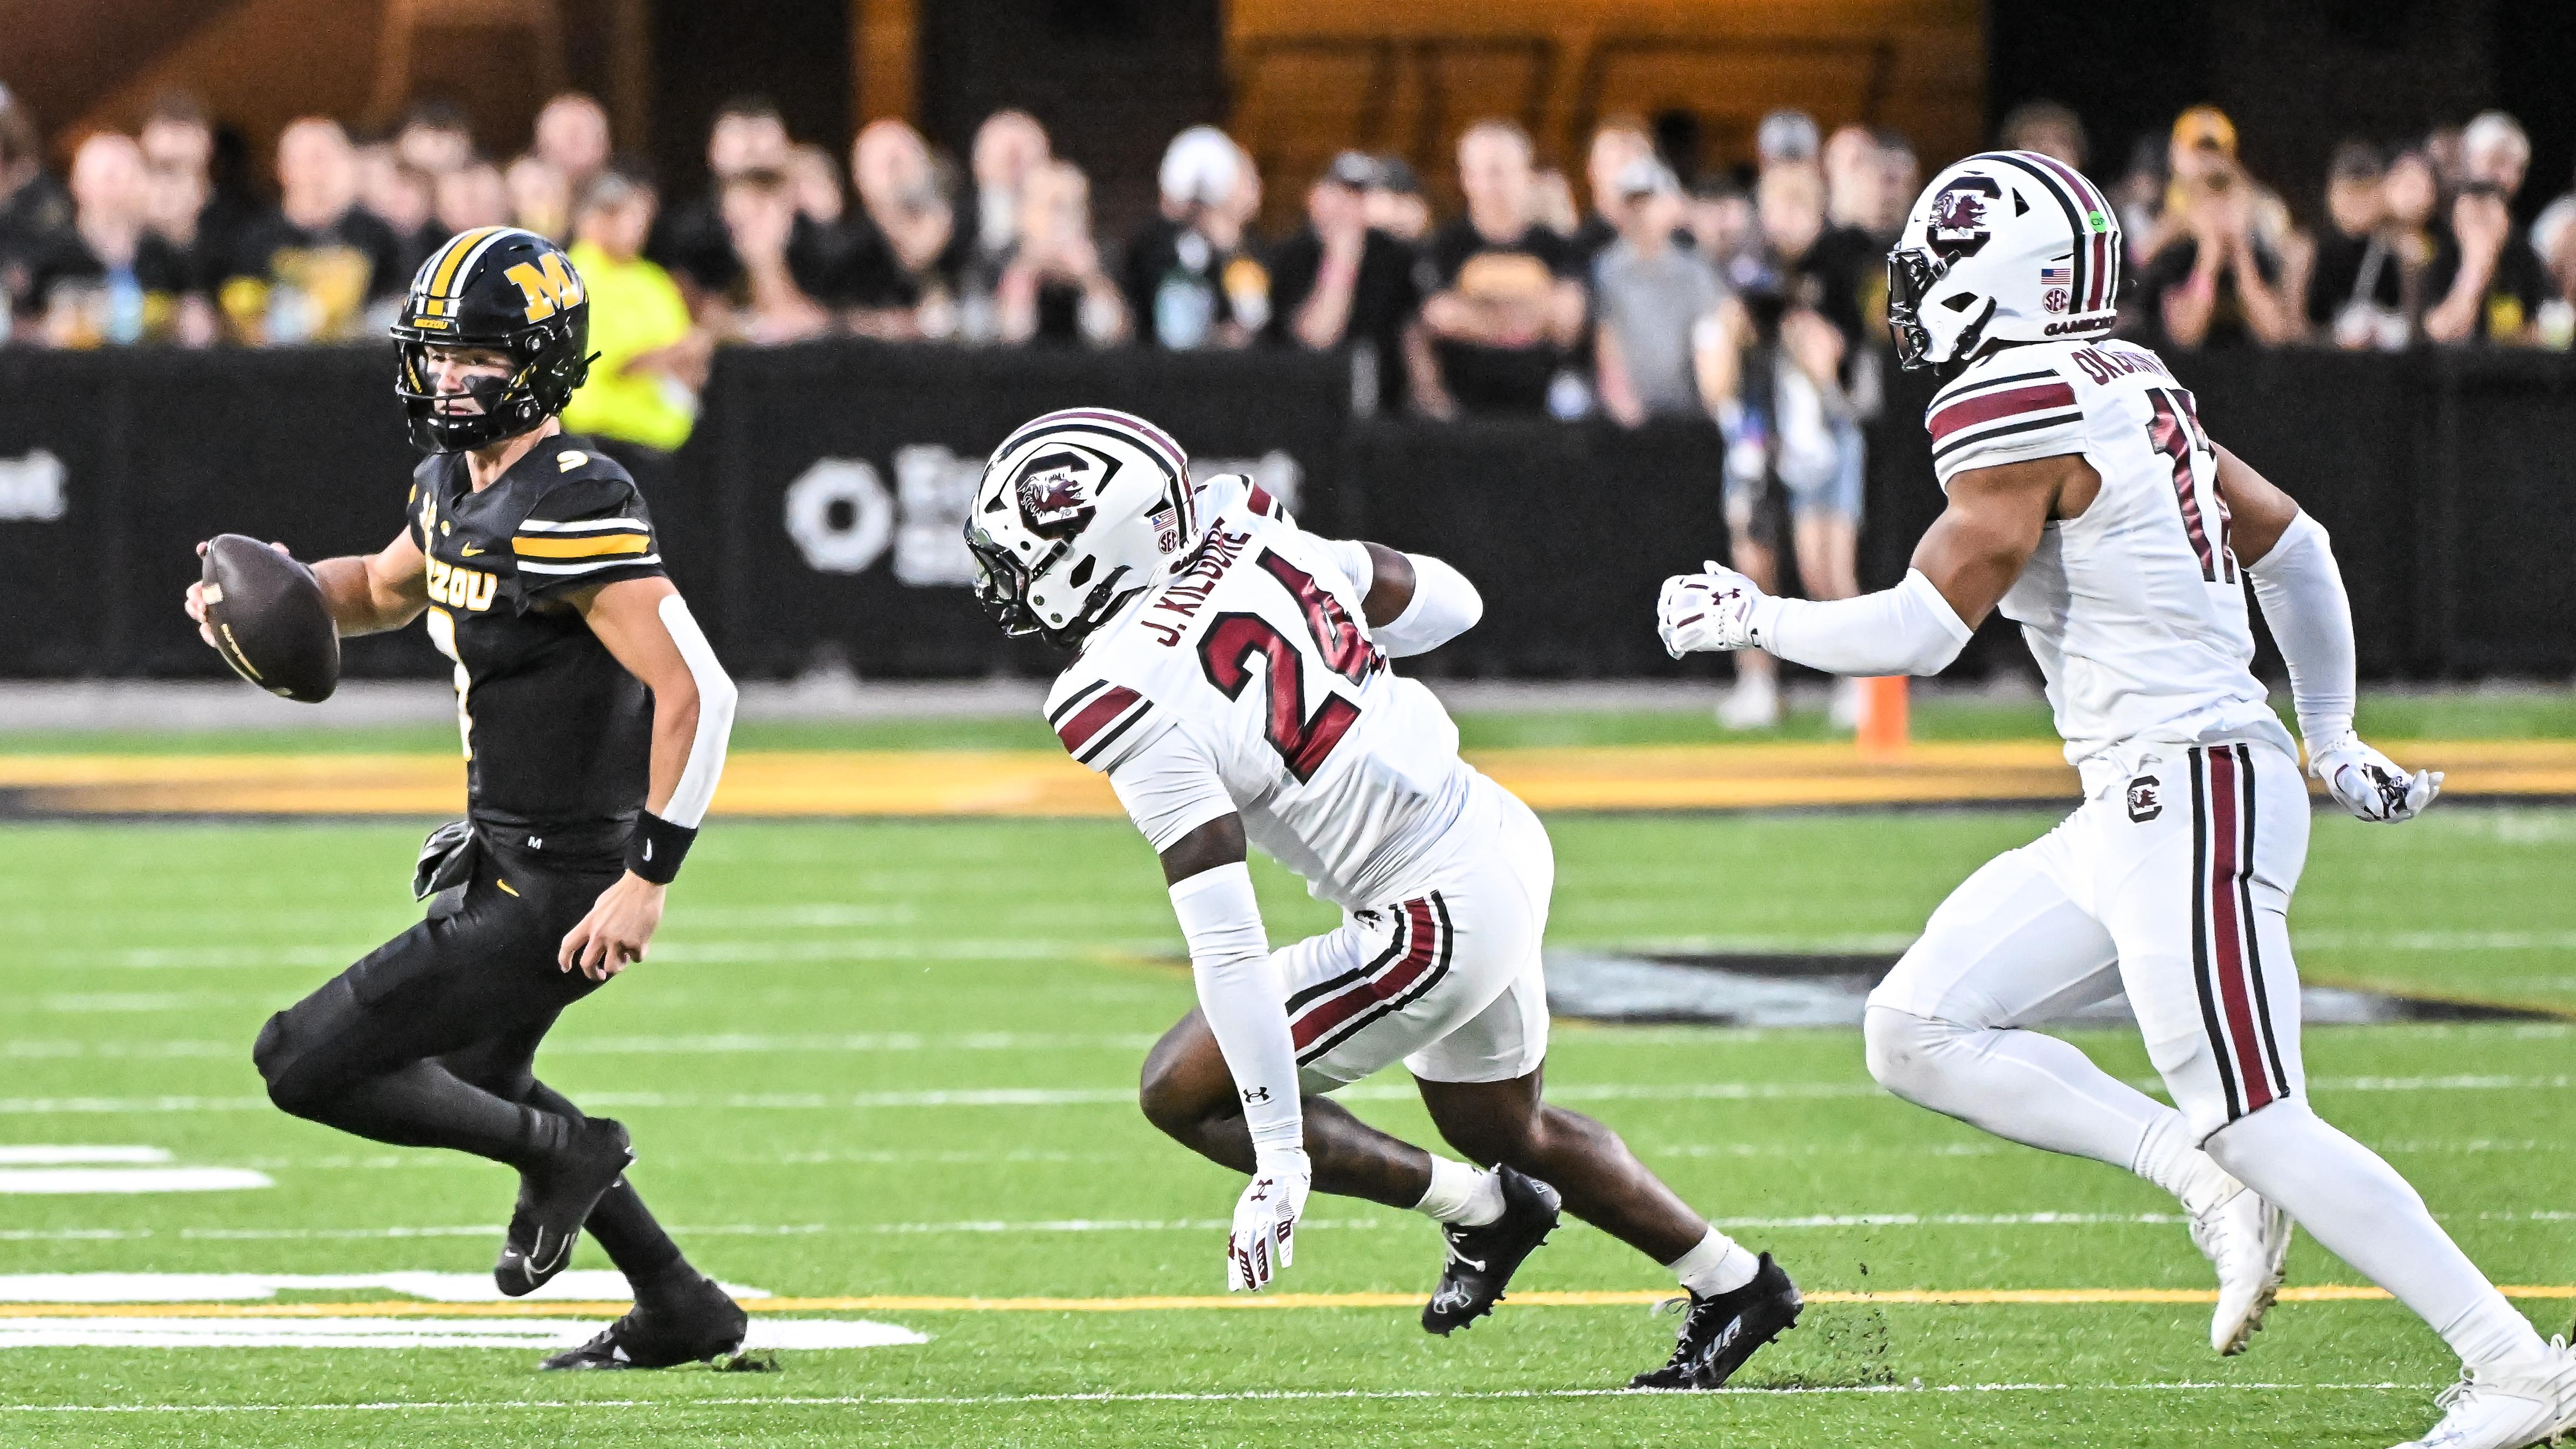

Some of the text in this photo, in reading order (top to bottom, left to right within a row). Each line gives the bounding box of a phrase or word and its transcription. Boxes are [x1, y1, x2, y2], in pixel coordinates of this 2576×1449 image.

[504, 252, 584, 324] M
[2046, 289, 2068, 312] SEC
[1160, 530, 1177, 553] SEC
[1141, 620, 1187, 647] J.
[1196, 546, 1387, 786] 24
